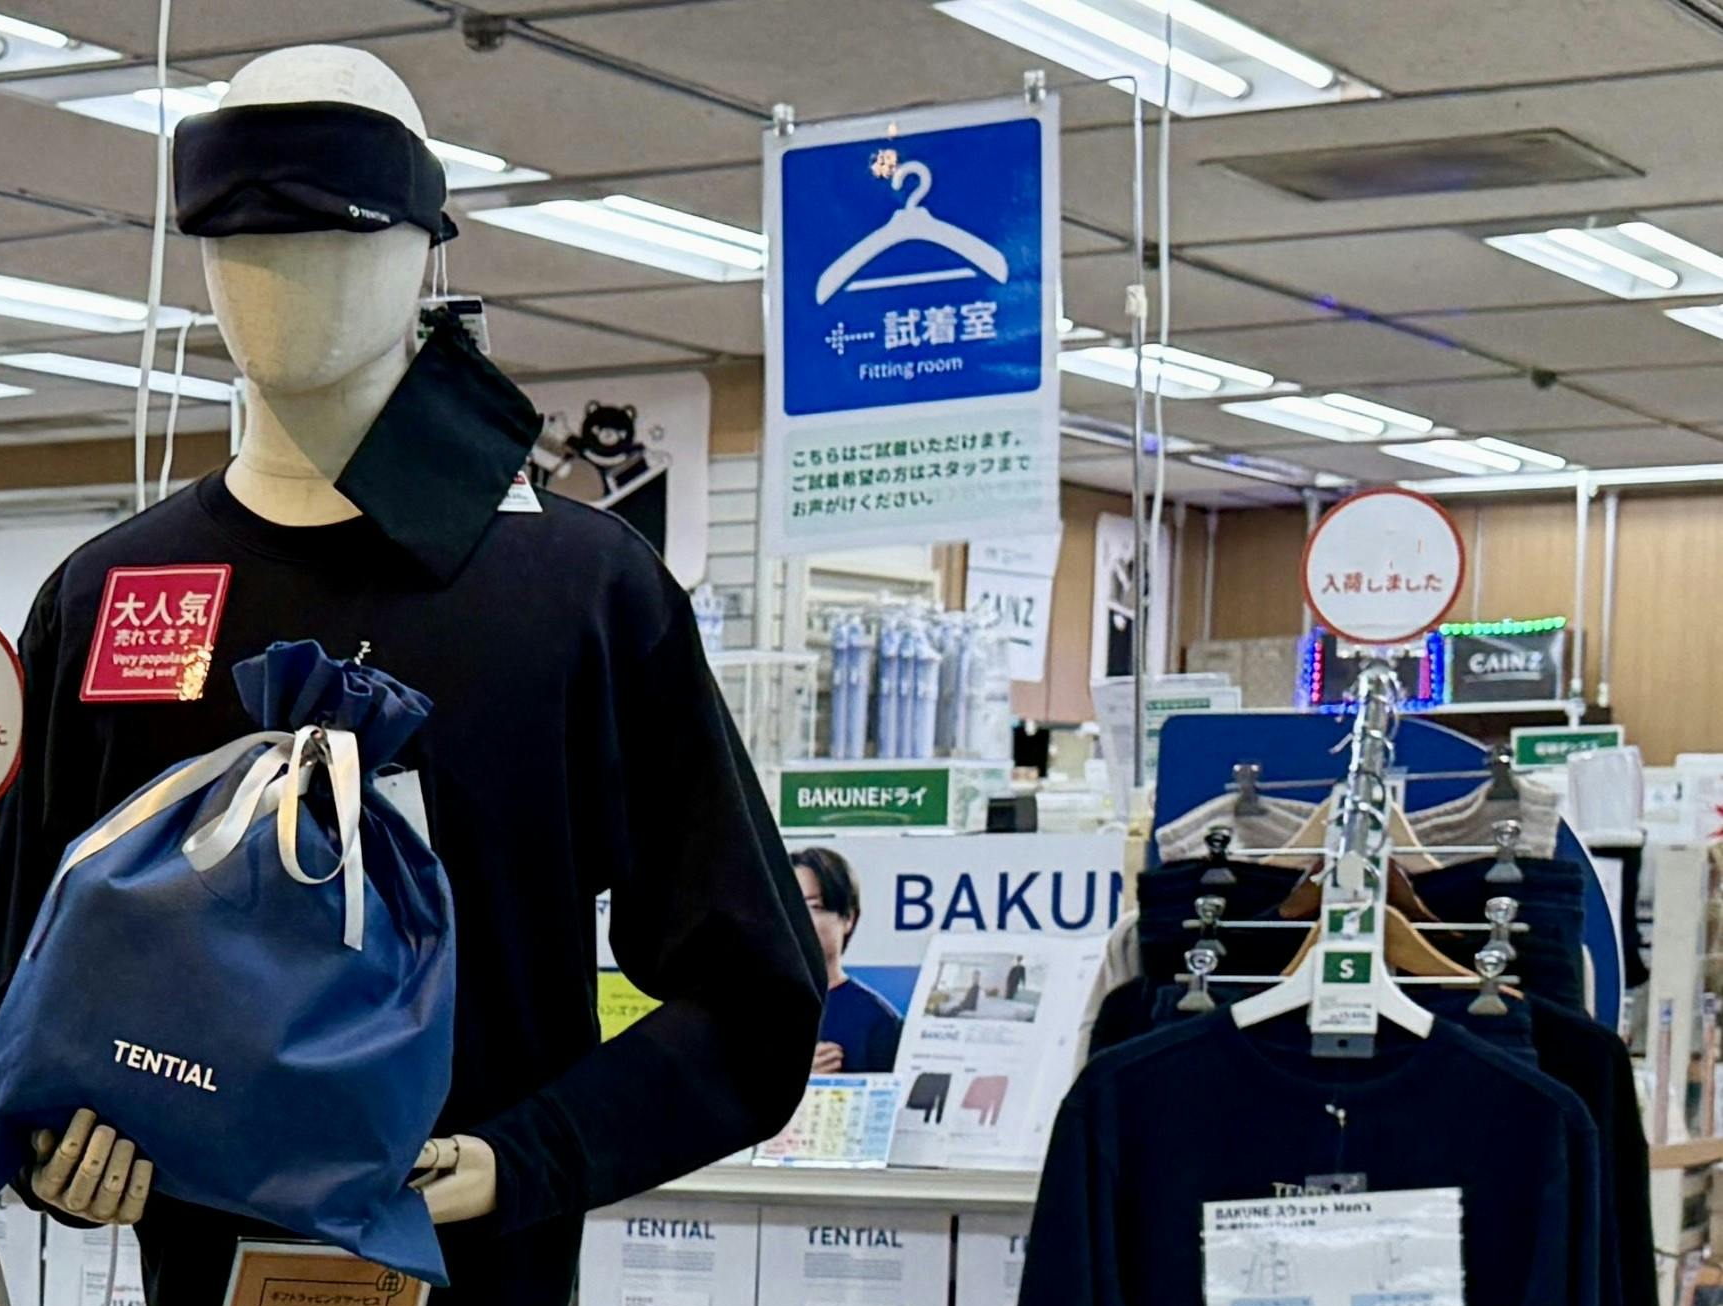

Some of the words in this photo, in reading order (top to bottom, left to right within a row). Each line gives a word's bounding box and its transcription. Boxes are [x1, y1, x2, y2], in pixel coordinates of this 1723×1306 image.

[883, 301, 997, 350] 試着室
[859, 359, 914, 381] Fitting
[917, 356, 964, 374] room
[791, 454, 1031, 492] ご試着希望の方はスタッフまで
[1321, 570, 1444, 594] 入荷しました
[111, 590, 213, 627] 大人気
[113, 628, 194, 648] 売れてます
[1468, 650, 1544, 675] CAINZ
[797, 786, 927, 808] BAKUNEドライ
[1338, 959, 1356, 980] S
[113, 1039, 218, 1092] TENTIAL
[625, 1217, 717, 1240] TENTIAL
[807, 1226, 904, 1249] TENTIAL
